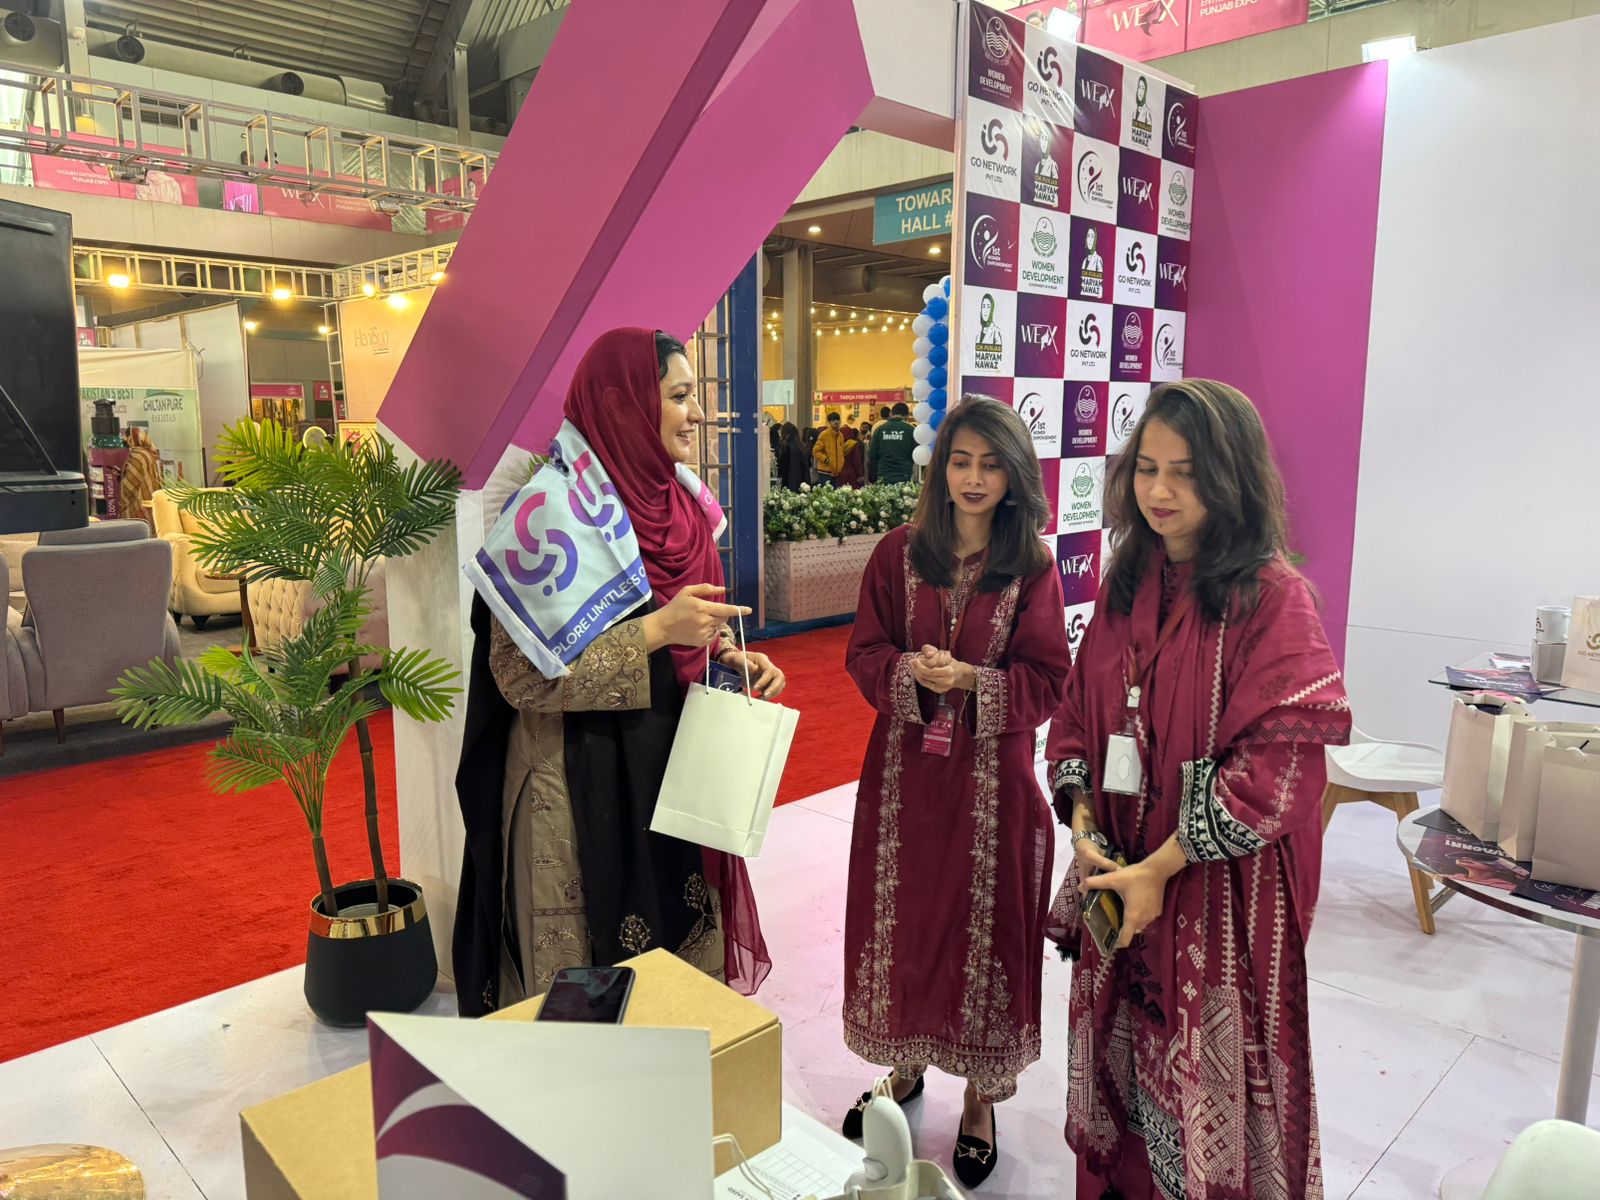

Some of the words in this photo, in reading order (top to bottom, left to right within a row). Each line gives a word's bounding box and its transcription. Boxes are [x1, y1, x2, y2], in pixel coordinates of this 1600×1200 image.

[1200, 1, 1234, 17] PUNJAB
[987, 69, 1006, 81] WOMEN
[979, 76, 1012, 94] DEVELOPMENT
[1027, 81, 1039, 92] GO
[970, 156, 982, 167] GO
[982, 159, 1017, 177] NETWORK
[56, 168, 78, 177] WOMEN
[1035, 183, 1058, 194] MARYAM
[1035, 190, 1055, 203] NAWAZ
[1167, 208, 1185, 219] WOMEN
[901, 213, 942, 235] HALL
[991, 246, 1000, 256] 1st
[1031, 260, 1055, 272] WOMEN
[1022, 270, 1064, 285] DEVELOPMENT
[1081, 278, 1103, 287] MARYAM
[1118, 274, 1126, 283] GO
[1127, 276, 1152, 287] NETWORK
[1081, 286, 1100, 295] NAWAZ
[975, 353, 1002, 361] MARYAM
[1070, 349, 1079, 358] GO
[1080, 350, 1107, 359] NETWORK
[975, 361, 998, 369] NAWAZ
[1037, 421, 1046, 430] 1st
[1072, 436, 1098, 445] DEVELOPMENT
[105, 473, 114, 497] Natural
[1071, 501, 1091, 510] WOMEN
[1063, 510, 1100, 522] DEVELOPMENT
[551, 618, 591, 660] PLORE
[590, 575, 641, 627] LIMITLESS
